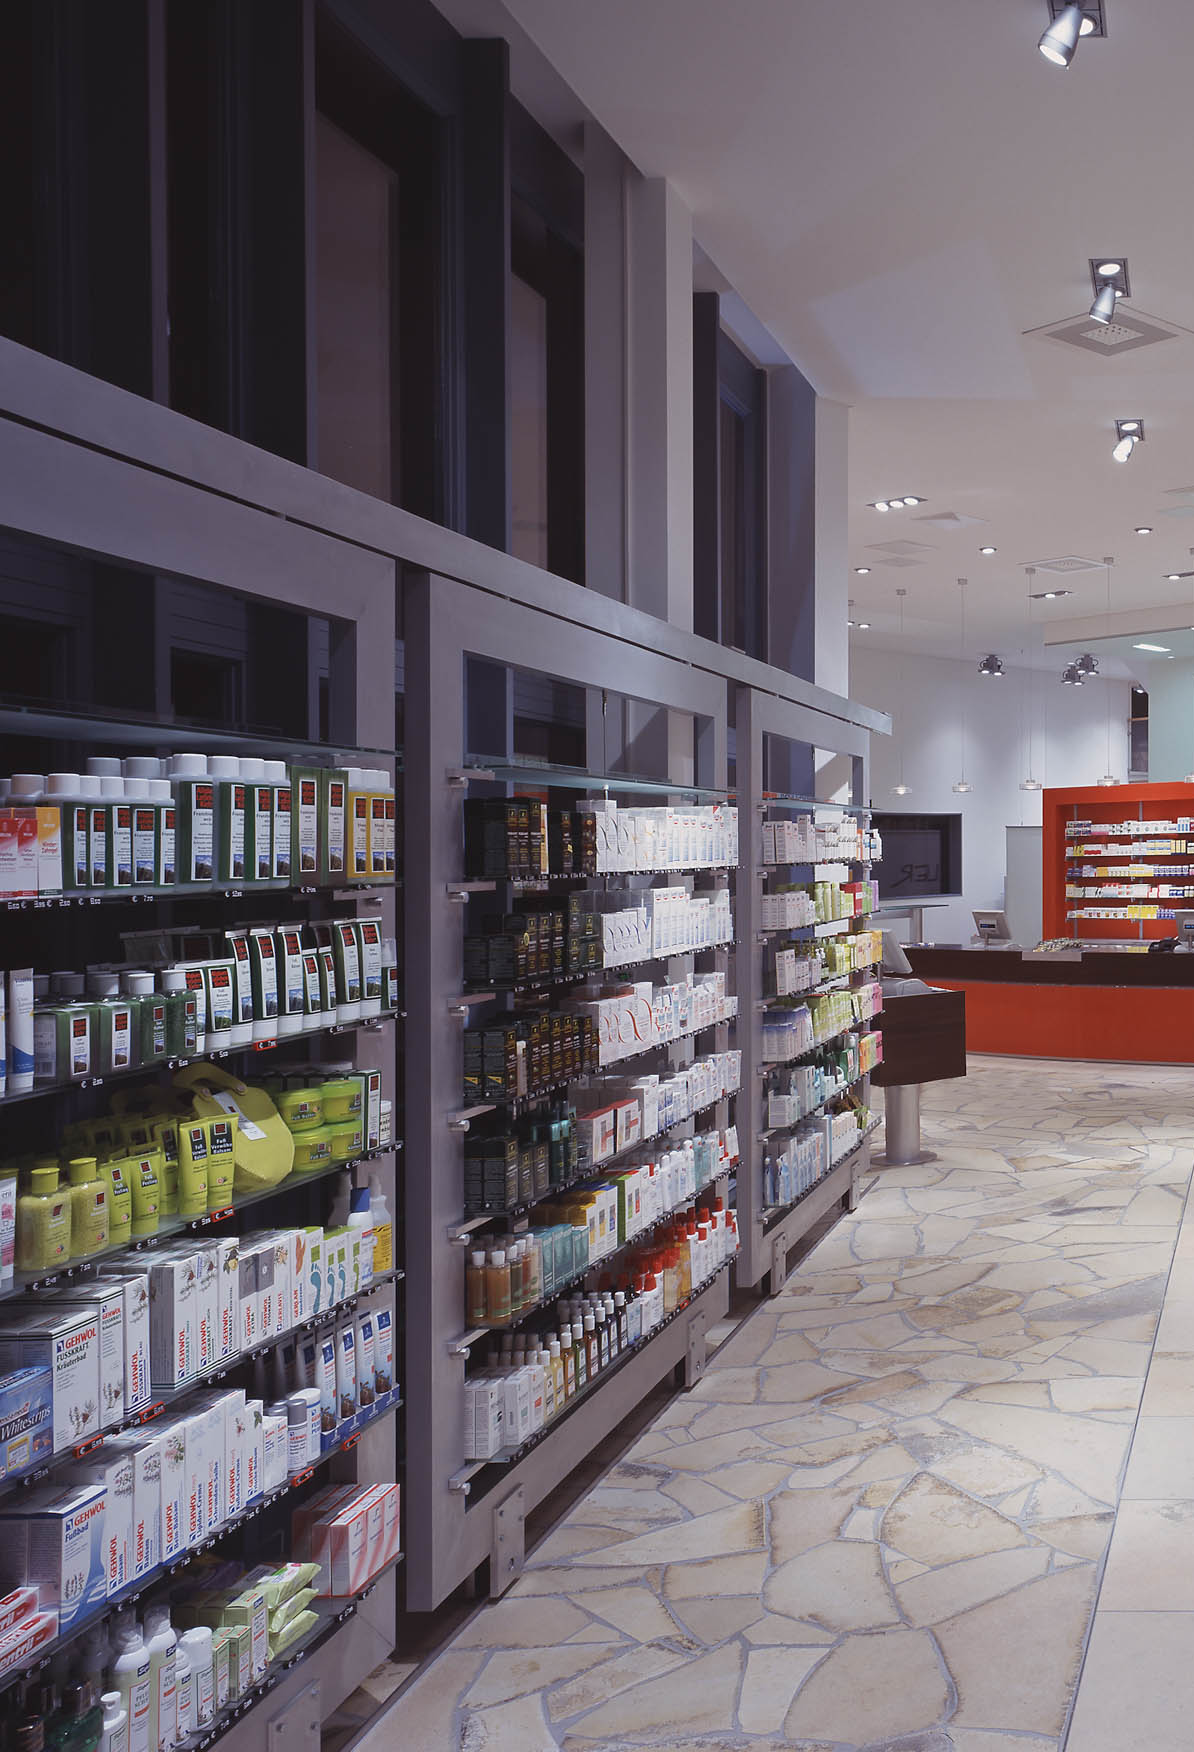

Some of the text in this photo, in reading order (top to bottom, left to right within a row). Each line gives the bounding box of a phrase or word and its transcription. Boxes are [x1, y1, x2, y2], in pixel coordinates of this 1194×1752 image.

[102, 1308, 120, 1320] GEHWOL
[65, 1328, 96, 1350] GEHWOL
[56, 1342, 89, 1363] FUSSKRAFT
[56, 1352, 87, 1373] Kräuterbad
[0, 1406, 51, 1442] Whitestrips
[74, 1500, 106, 1526] GEHWOL
[64, 1522, 89, 1544] Fußbad
[136, 1520, 144, 1562] GEHWOL
[110, 1536, 118, 1578] GEHWOL
